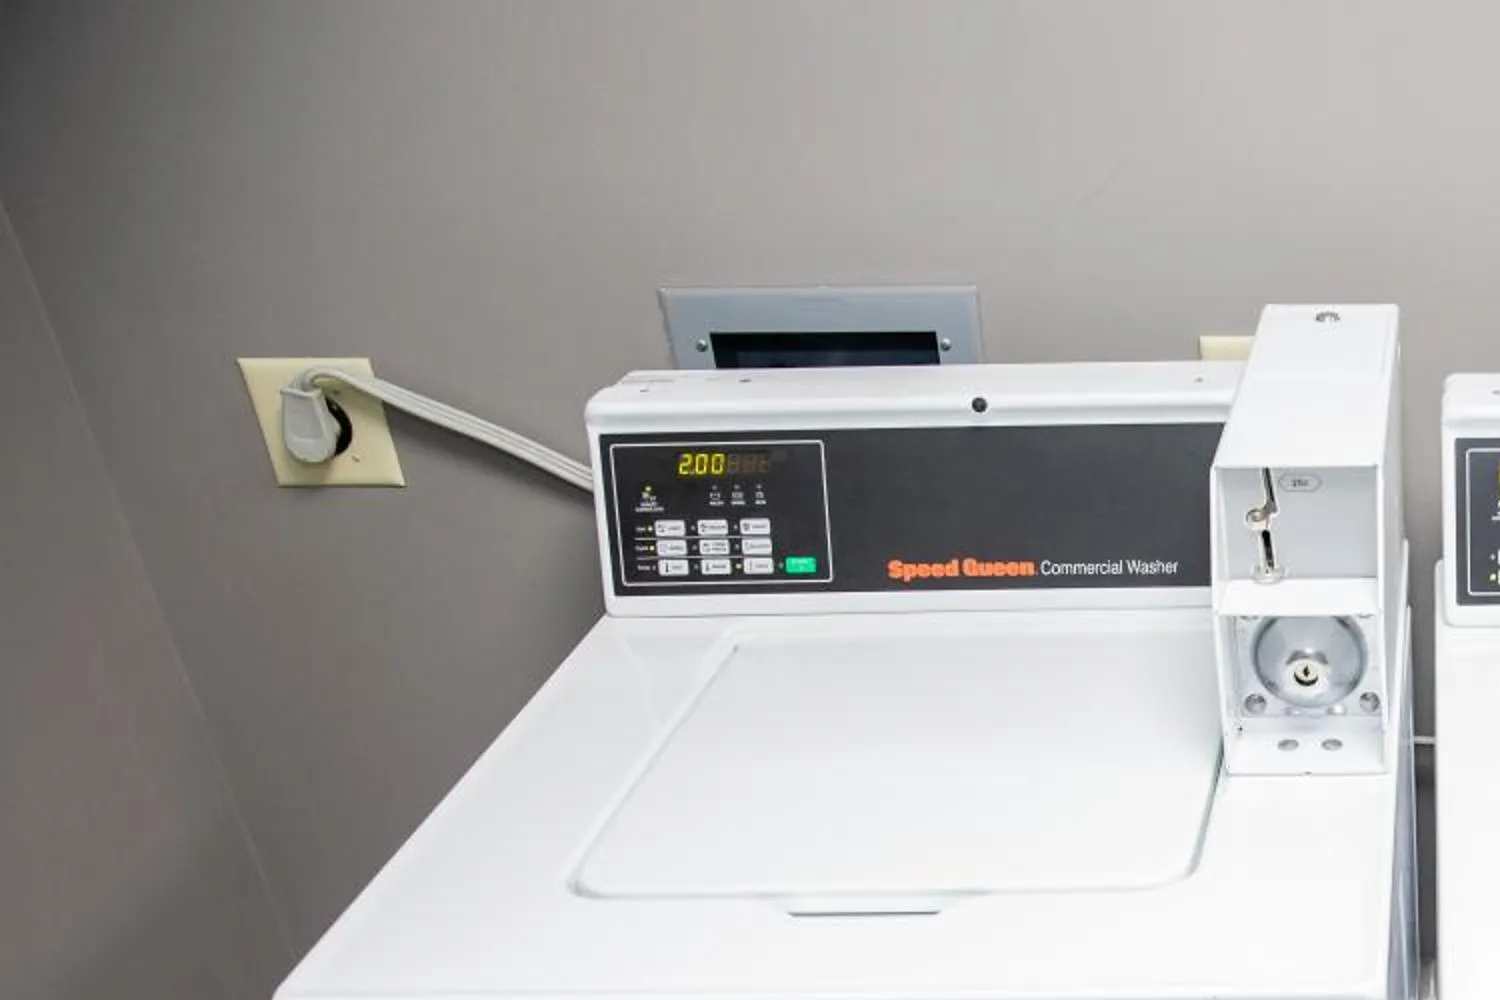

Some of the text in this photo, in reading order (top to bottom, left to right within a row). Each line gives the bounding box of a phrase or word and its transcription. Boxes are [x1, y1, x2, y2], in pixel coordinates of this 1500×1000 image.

[887, 557, 1179, 581] Speed Queen Commercial Washer
